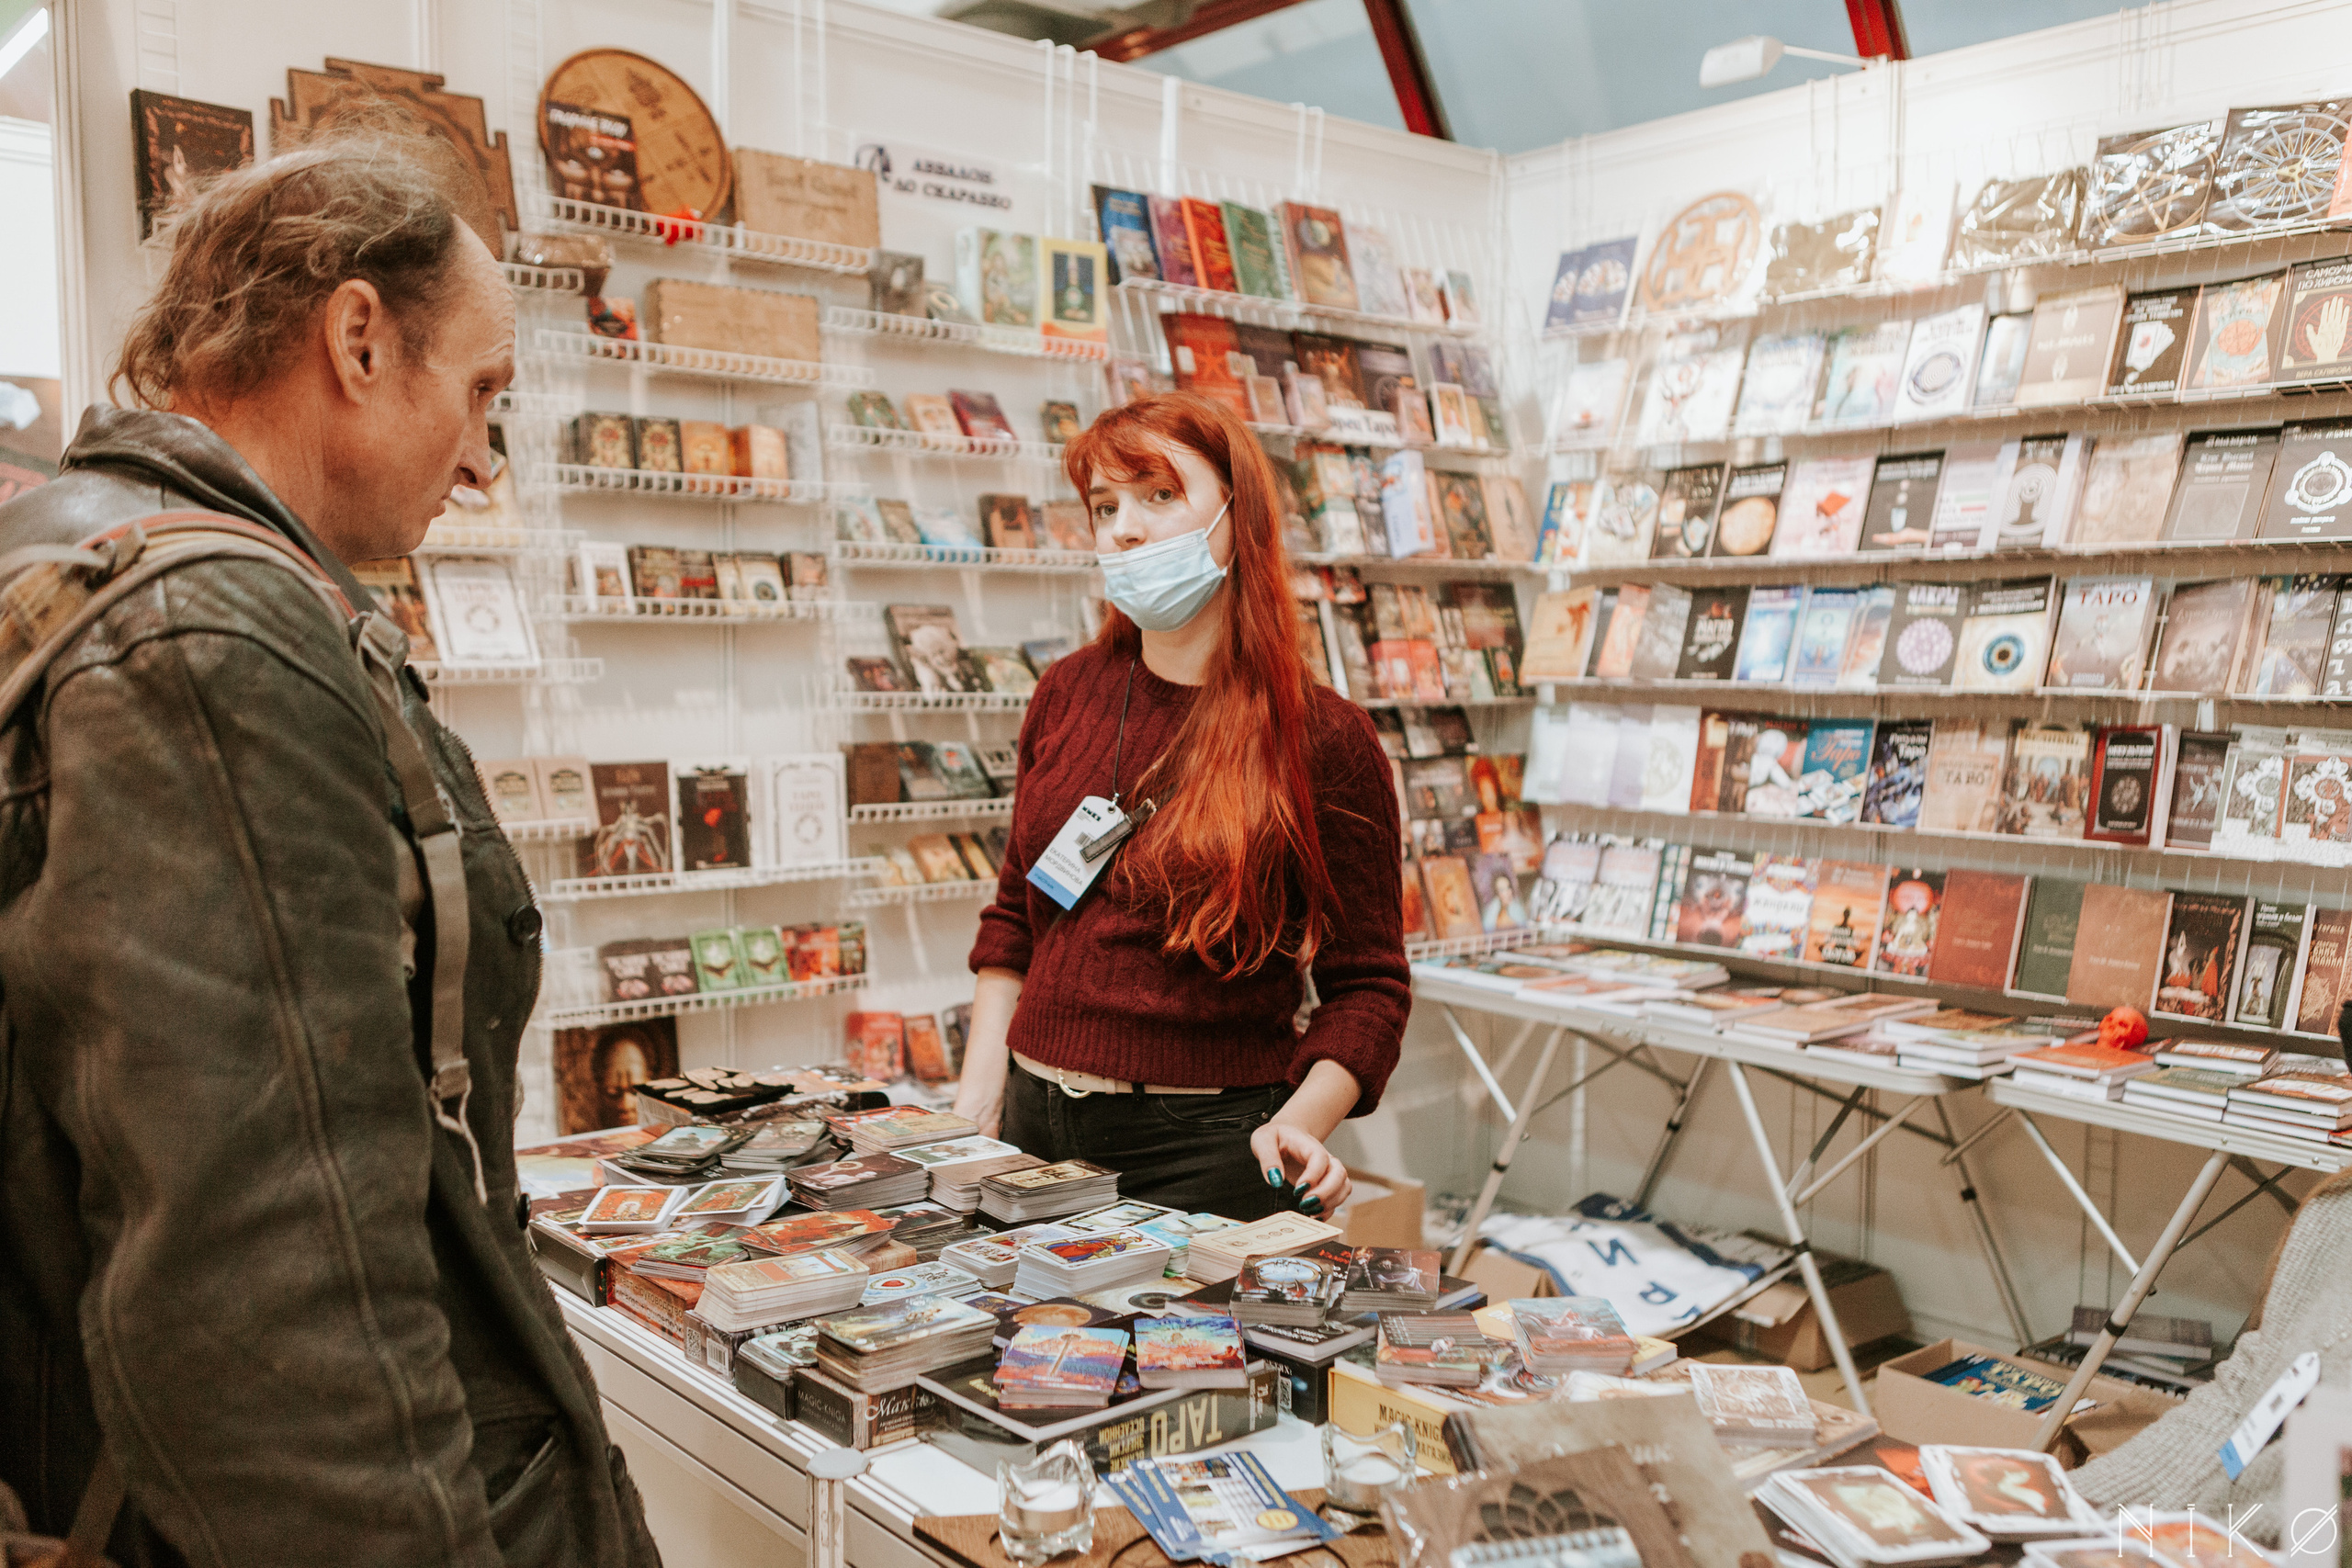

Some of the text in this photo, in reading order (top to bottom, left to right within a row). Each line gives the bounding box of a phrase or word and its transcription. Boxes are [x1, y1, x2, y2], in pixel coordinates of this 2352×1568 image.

[2298, 279, 2314, 291] ПО
[2080, 589, 2138, 604] ТАРО
[1045, 854, 1083, 886] МОРДВИНОВА
[1049, 847, 1081, 873] ЕКАТЕРИНА
[1098, 1416, 1146, 1446] ВСЕЛЕННОЙ
[1150, 1393, 1223, 1458] ТАРО
[1379, 1404, 1443, 1442] MAGIC-KNIG
